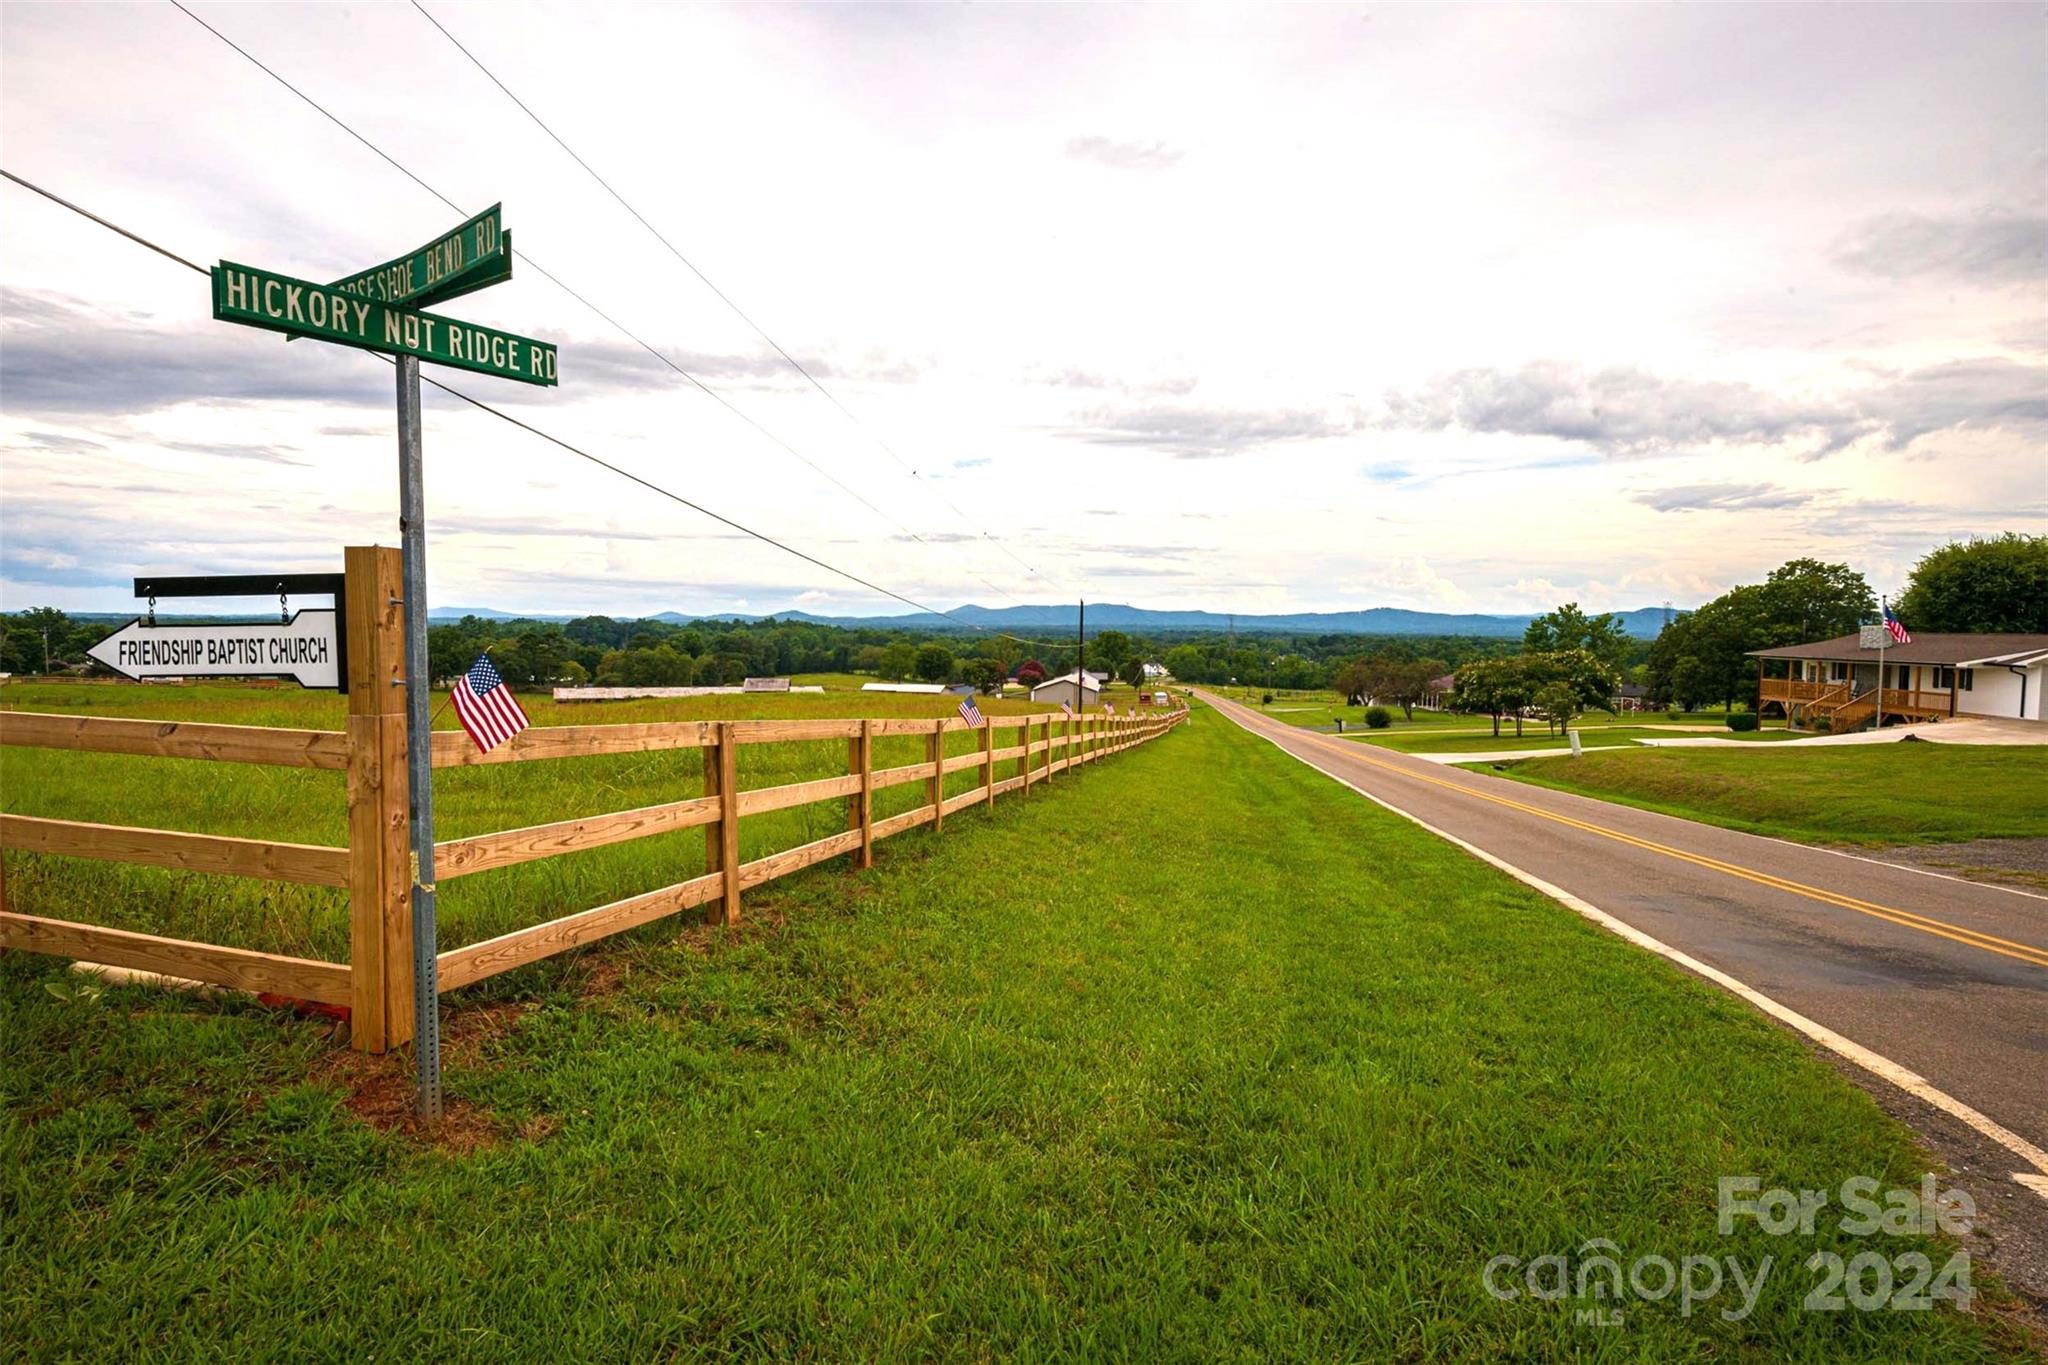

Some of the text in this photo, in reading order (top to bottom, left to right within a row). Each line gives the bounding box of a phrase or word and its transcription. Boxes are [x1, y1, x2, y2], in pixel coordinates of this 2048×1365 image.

[426, 234, 463, 284] BEND
[476, 214, 496, 258] RD
[226, 270, 371, 336] HICKORY
[448, 325, 520, 371] RIDGE
[531, 346, 557, 380] RD
[118, 637, 329, 666] FRIENDSHIP BAPTIST CHURCH
